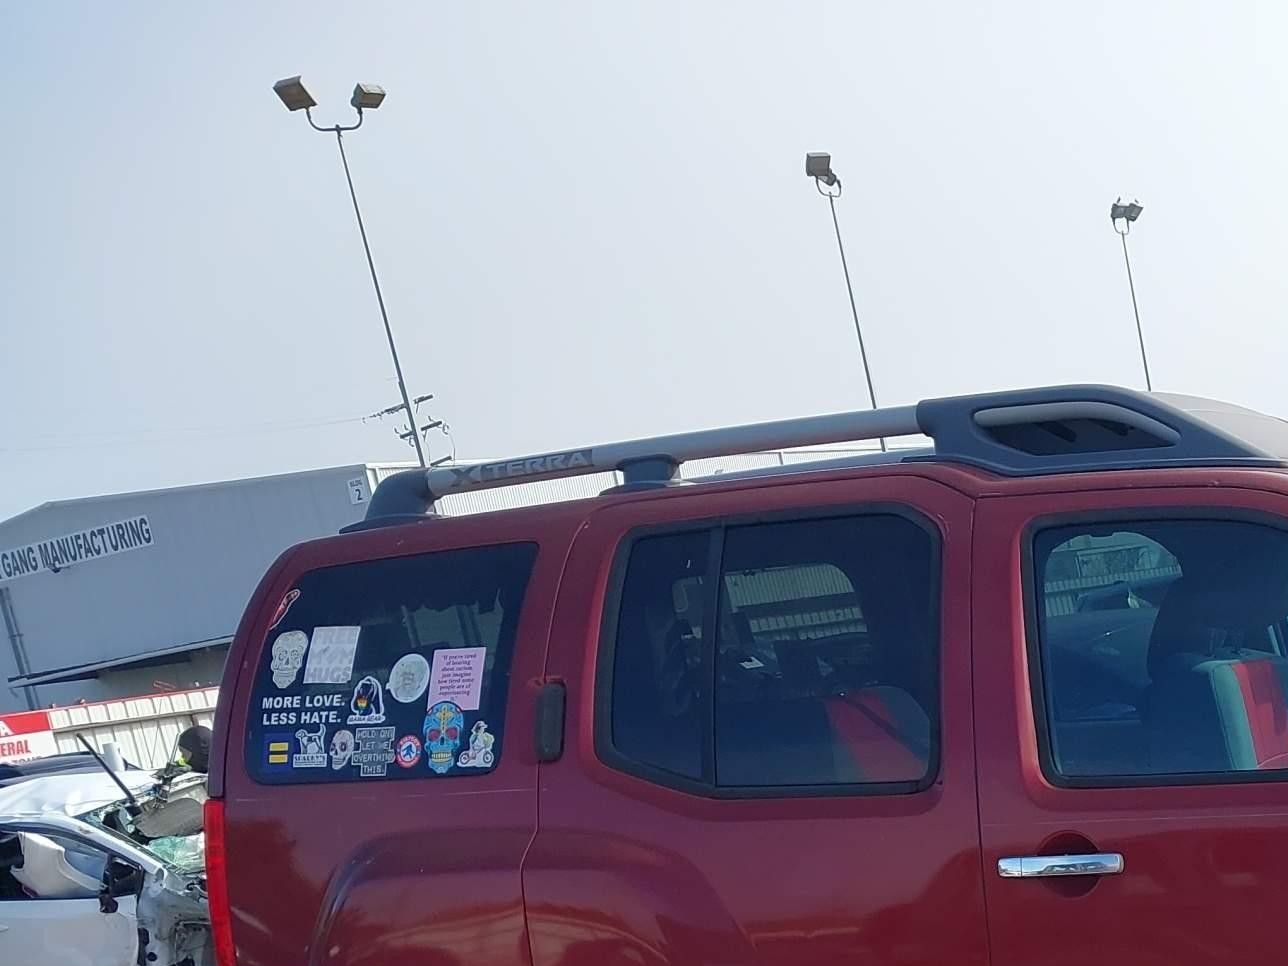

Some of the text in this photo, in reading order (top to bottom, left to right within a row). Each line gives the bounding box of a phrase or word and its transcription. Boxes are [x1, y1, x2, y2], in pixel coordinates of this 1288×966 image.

[450, 451, 585, 487] XTERRA
[355, 488, 363, 501] 2
[1, 517, 152, 578] GANG MANUFACTURING
[262, 694, 345, 709] MORE LOVE.
[262, 711, 342, 725] LESS HATE.
